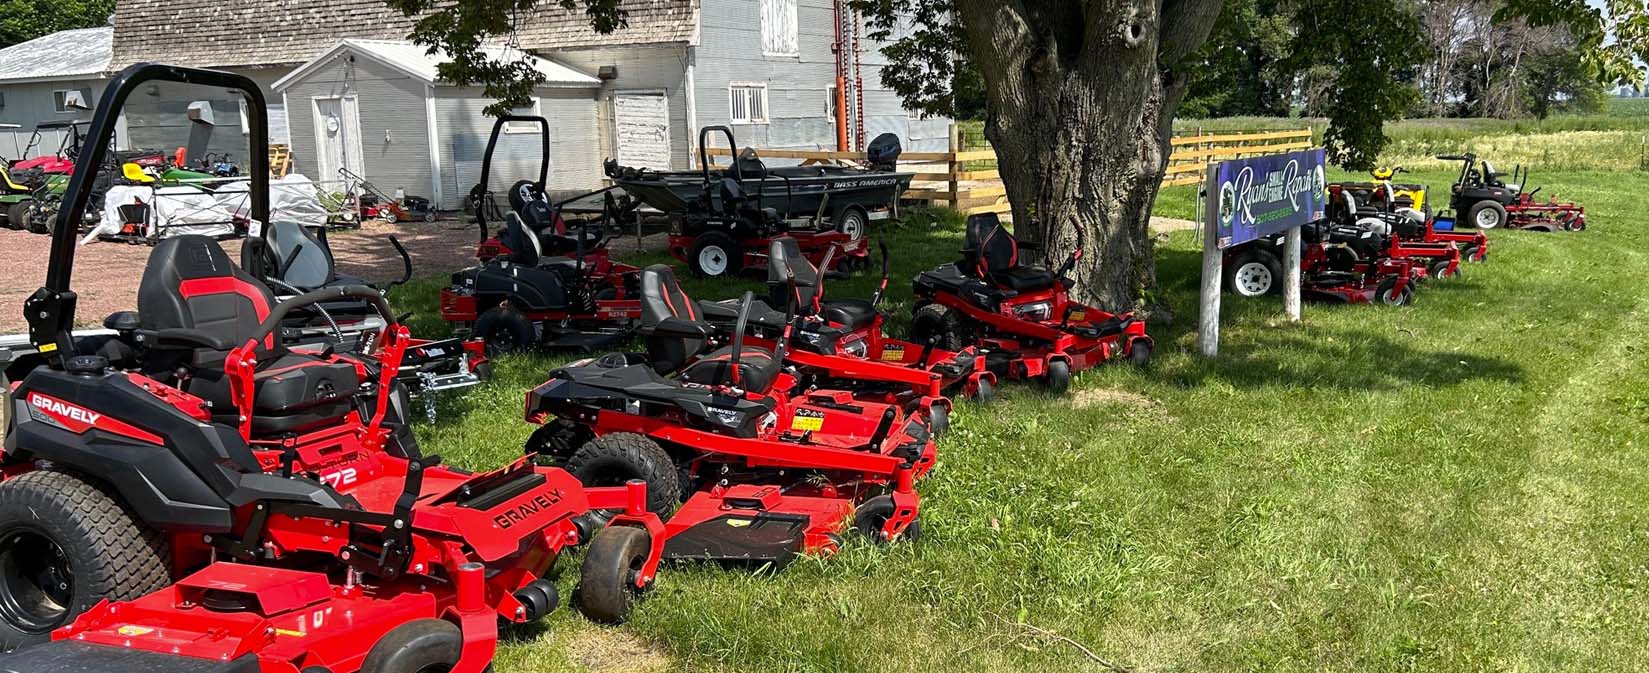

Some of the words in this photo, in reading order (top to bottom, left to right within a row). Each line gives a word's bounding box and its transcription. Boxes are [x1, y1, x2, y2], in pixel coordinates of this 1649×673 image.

[1234, 166, 1270, 225] Ryan's
[1282, 159, 1313, 213] Repair
[32, 394, 101, 425] GRAVELY
[707, 407, 737, 415] GRAVELY
[494, 488, 563, 529] GRAVELY
